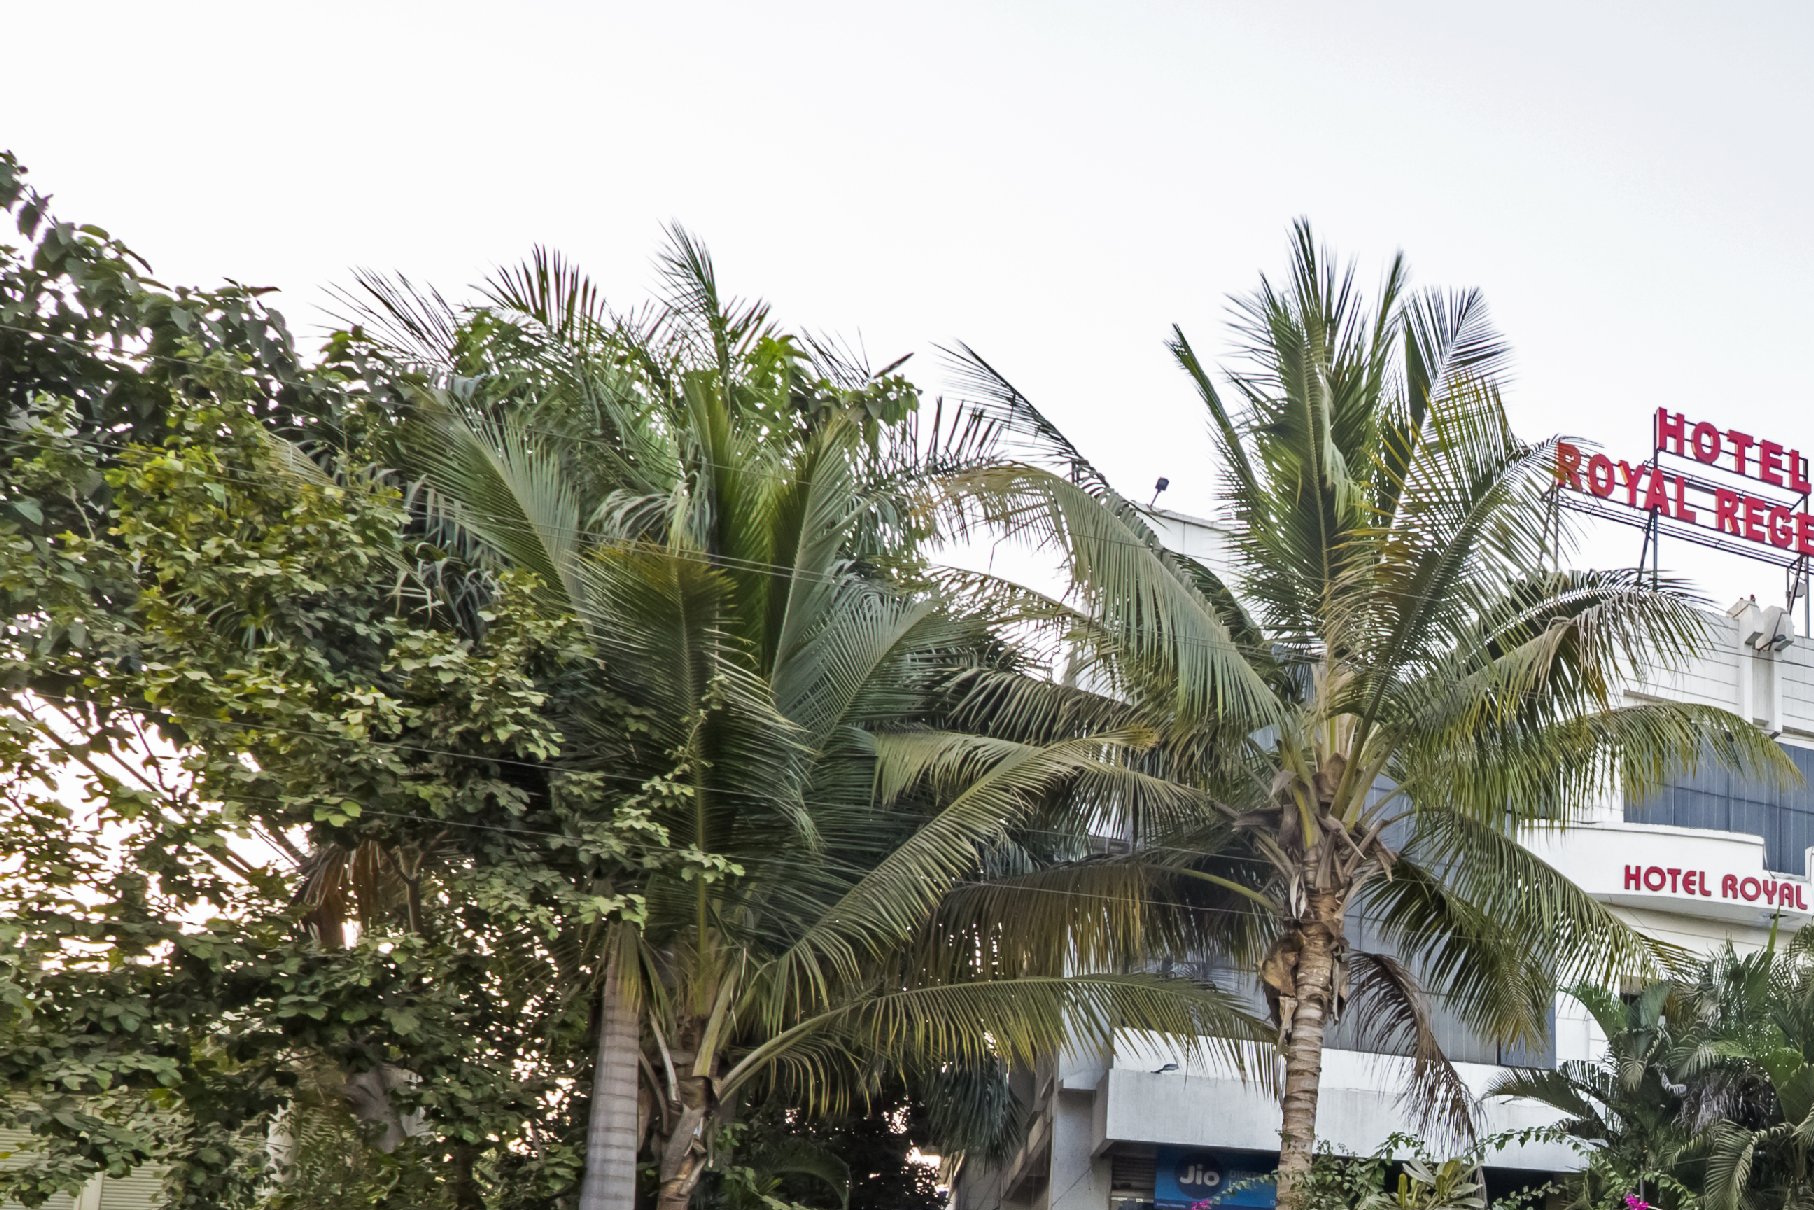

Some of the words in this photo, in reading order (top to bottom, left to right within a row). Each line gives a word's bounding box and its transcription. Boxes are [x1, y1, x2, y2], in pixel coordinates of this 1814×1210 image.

[1557, 439, 1696, 523] ROYAL
[1656, 406, 1812, 495] HOTEL
[1624, 865, 1711, 897] HOTEL
[1721, 874, 1808, 910] ROYAL
[1179, 1164, 1220, 1186] Jio
